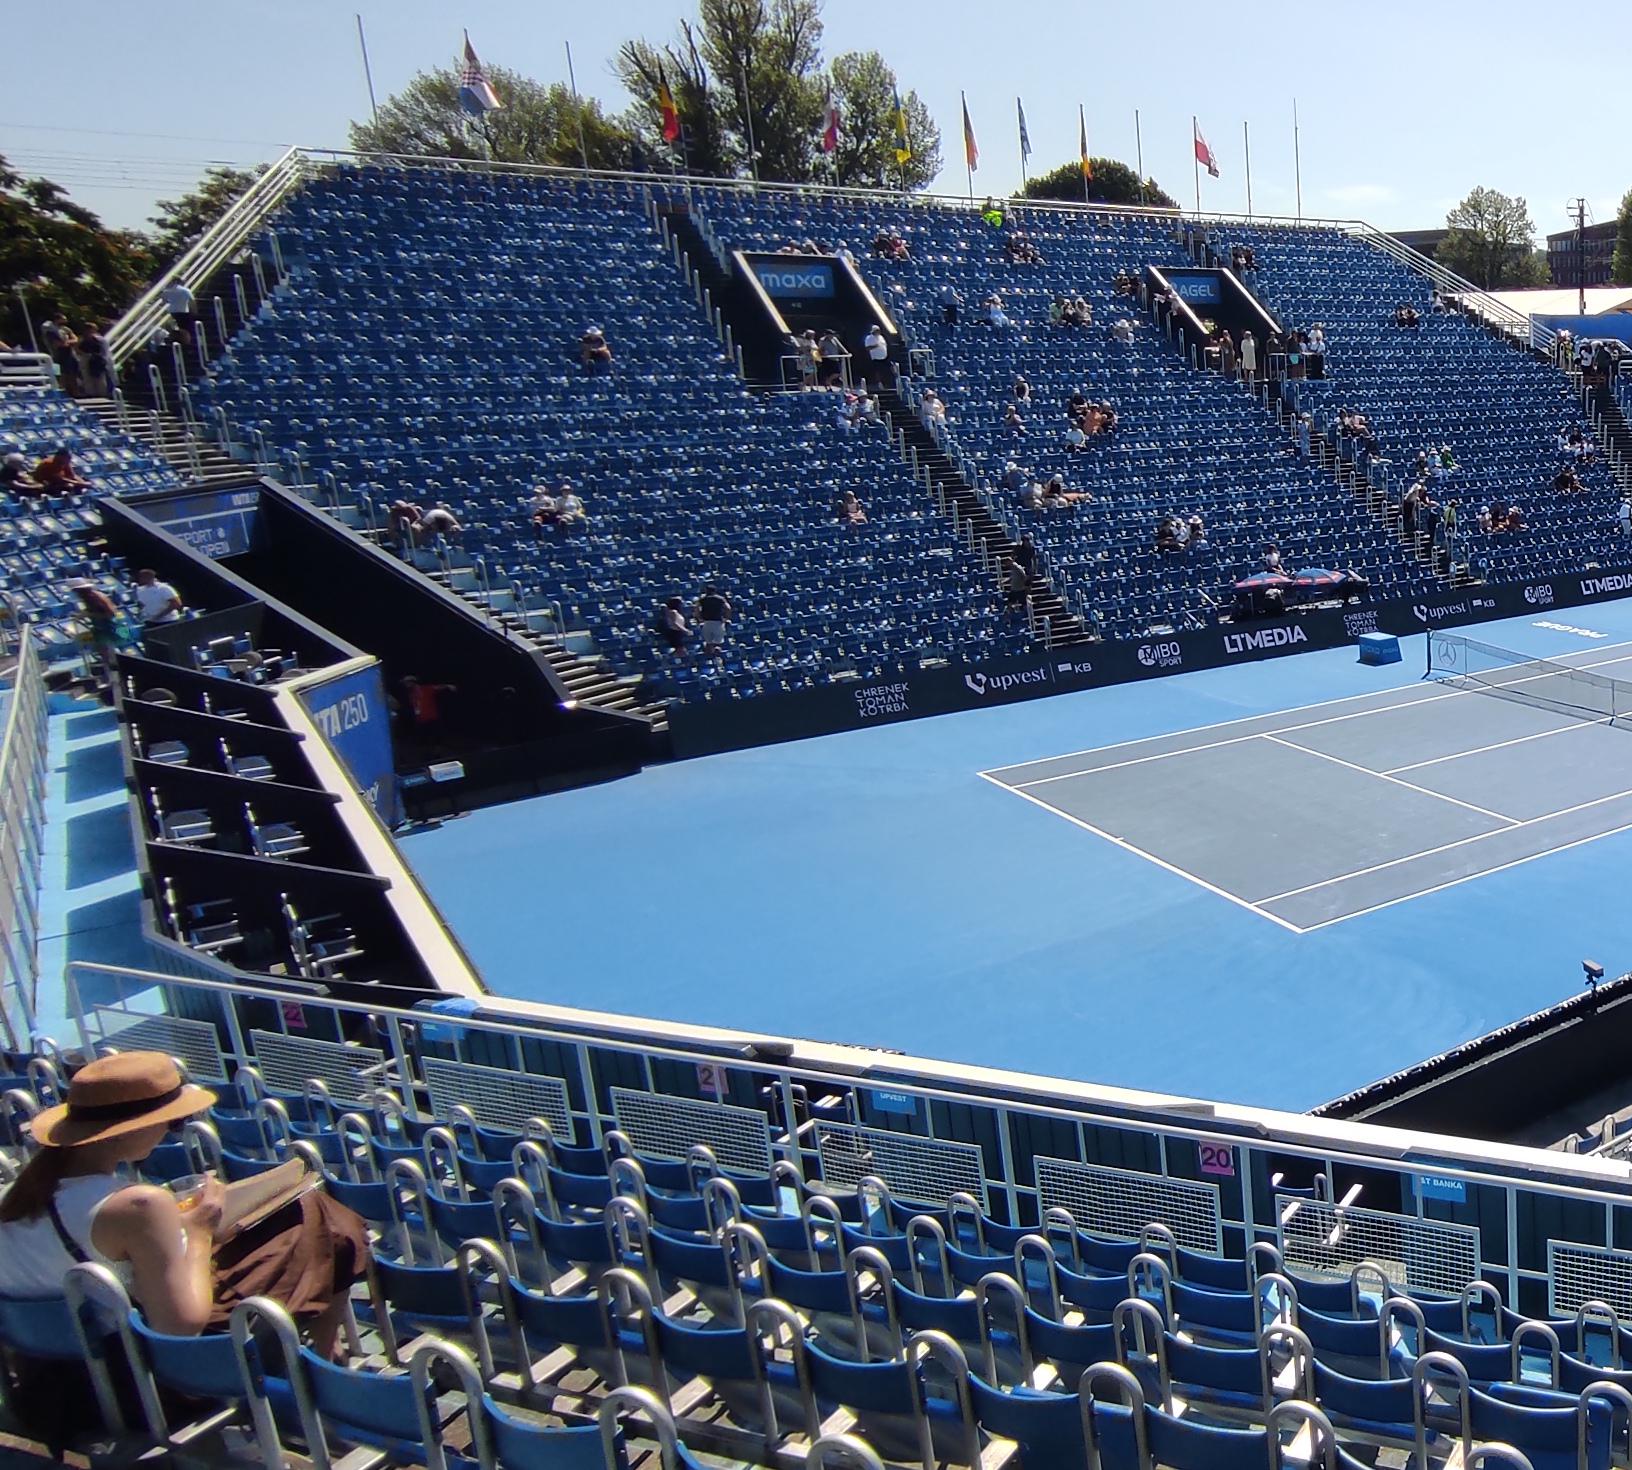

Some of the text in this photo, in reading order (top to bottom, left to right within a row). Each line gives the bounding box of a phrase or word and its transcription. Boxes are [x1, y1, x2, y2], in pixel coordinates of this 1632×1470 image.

[760, 272, 826, 289] maxa
[1180, 284, 1215, 297] AGEL
[1429, 602, 1467, 619] upvest
[1345, 618, 1376, 629] TOMAN
[989, 662, 1093, 691] upvest KB
[854, 681, 911, 699] CHRENEK
[857, 693, 906, 709] TOMAN
[341, 693, 369, 731] 250
[859, 702, 910, 718] KOTRBA
[1202, 1146, 1231, 1169] 20
[1433, 1179, 1463, 1190] BANKA
